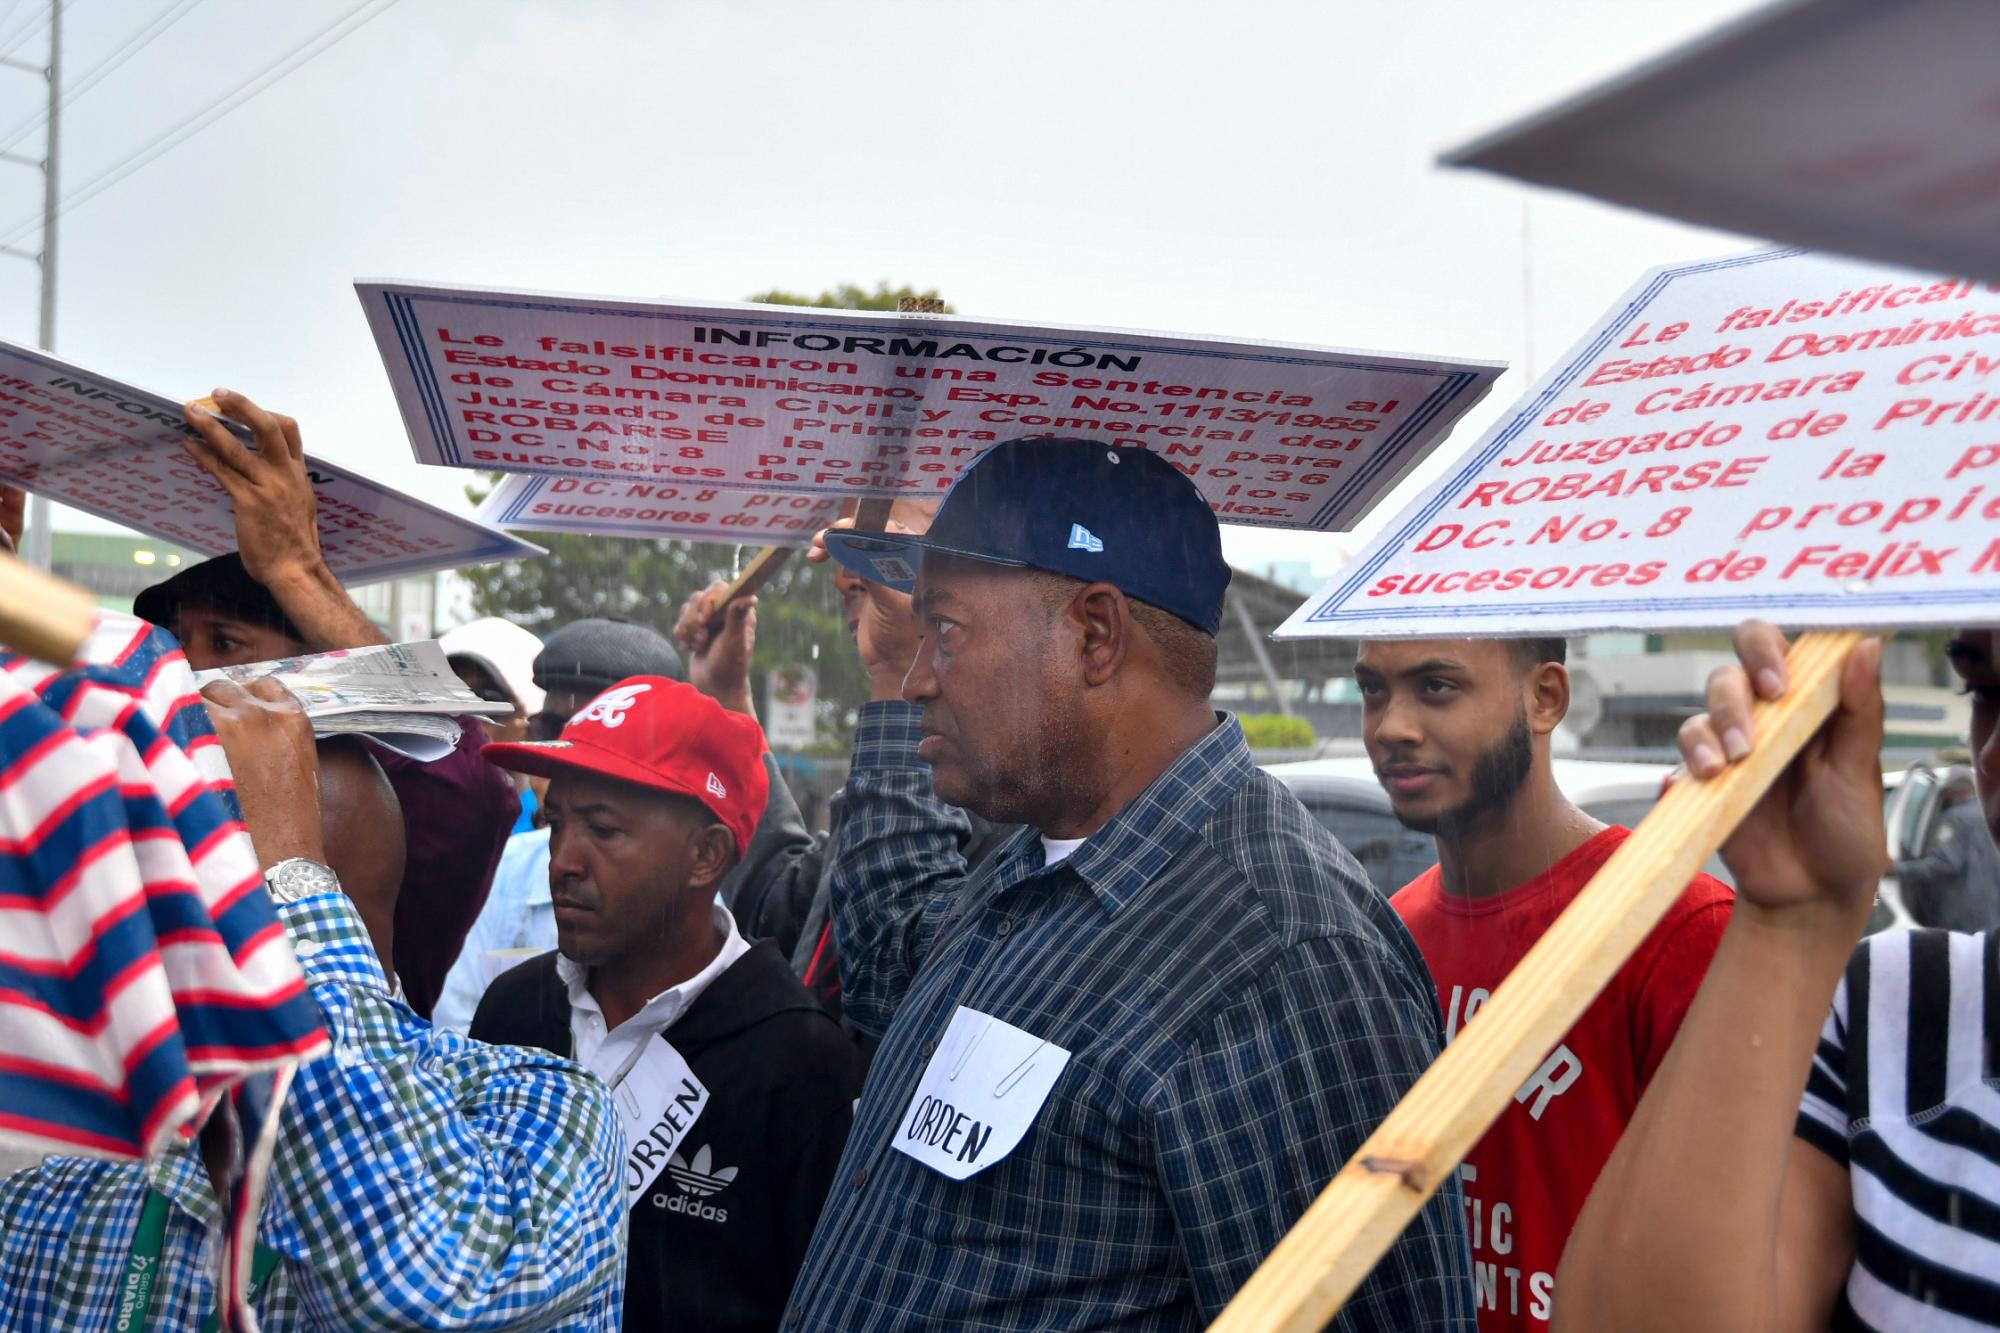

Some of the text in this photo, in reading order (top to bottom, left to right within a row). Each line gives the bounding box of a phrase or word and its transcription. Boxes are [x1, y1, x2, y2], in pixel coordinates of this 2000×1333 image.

[694, 327, 1142, 372] INFORMACIÓN
[1620, 322, 1690, 349] Le
[437, 328, 1400, 414] Le falsificaron una Sentencia al
[444, 349, 611, 376] Estado
[630, 364, 925, 401] Dominicano,
[947, 386, 1049, 407] Exp.
[1580, 344, 1752, 388] Estado
[450, 371, 514, 388] de
[541, 378, 747, 409] Cámara
[776, 397, 895, 417] Civil
[919, 409, 952, 423] y
[979, 409, 1255, 442] Comercial
[1279, 434, 1364, 451] del
[1543, 398, 1611, 427] de
[1634, 371, 1866, 416] Cámara
[457, 391, 679, 422] Juzgado
[704, 412, 766, 428] de
[793, 417, 997, 441] Primera
[1225, 450, 1343, 469] para
[462, 409, 730, 444] ROBARSE
[783, 435, 825, 451] la
[1501, 420, 1743, 468] Juzgado
[1766, 409, 1848, 441] de
[472, 449, 727, 478] sucesores
[744, 468, 799, 483] de
[815, 472, 922, 489] Felix
[1226, 484, 1312, 502] los
[1457, 455, 1770, 510] ROBARSE
[1818, 448, 1887, 481] la
[532, 501, 710, 524] sucesores
[720, 512, 760, 528] de
[1367, 561, 1668, 598] sucesores
[1684, 549, 1768, 584] de
[1777, 541, 1961, 581] Felix
[907, 1094, 993, 1165] ORDEN
[652, 1192, 729, 1223] adidas
[116, 1272, 141, 1332] DIARIO
